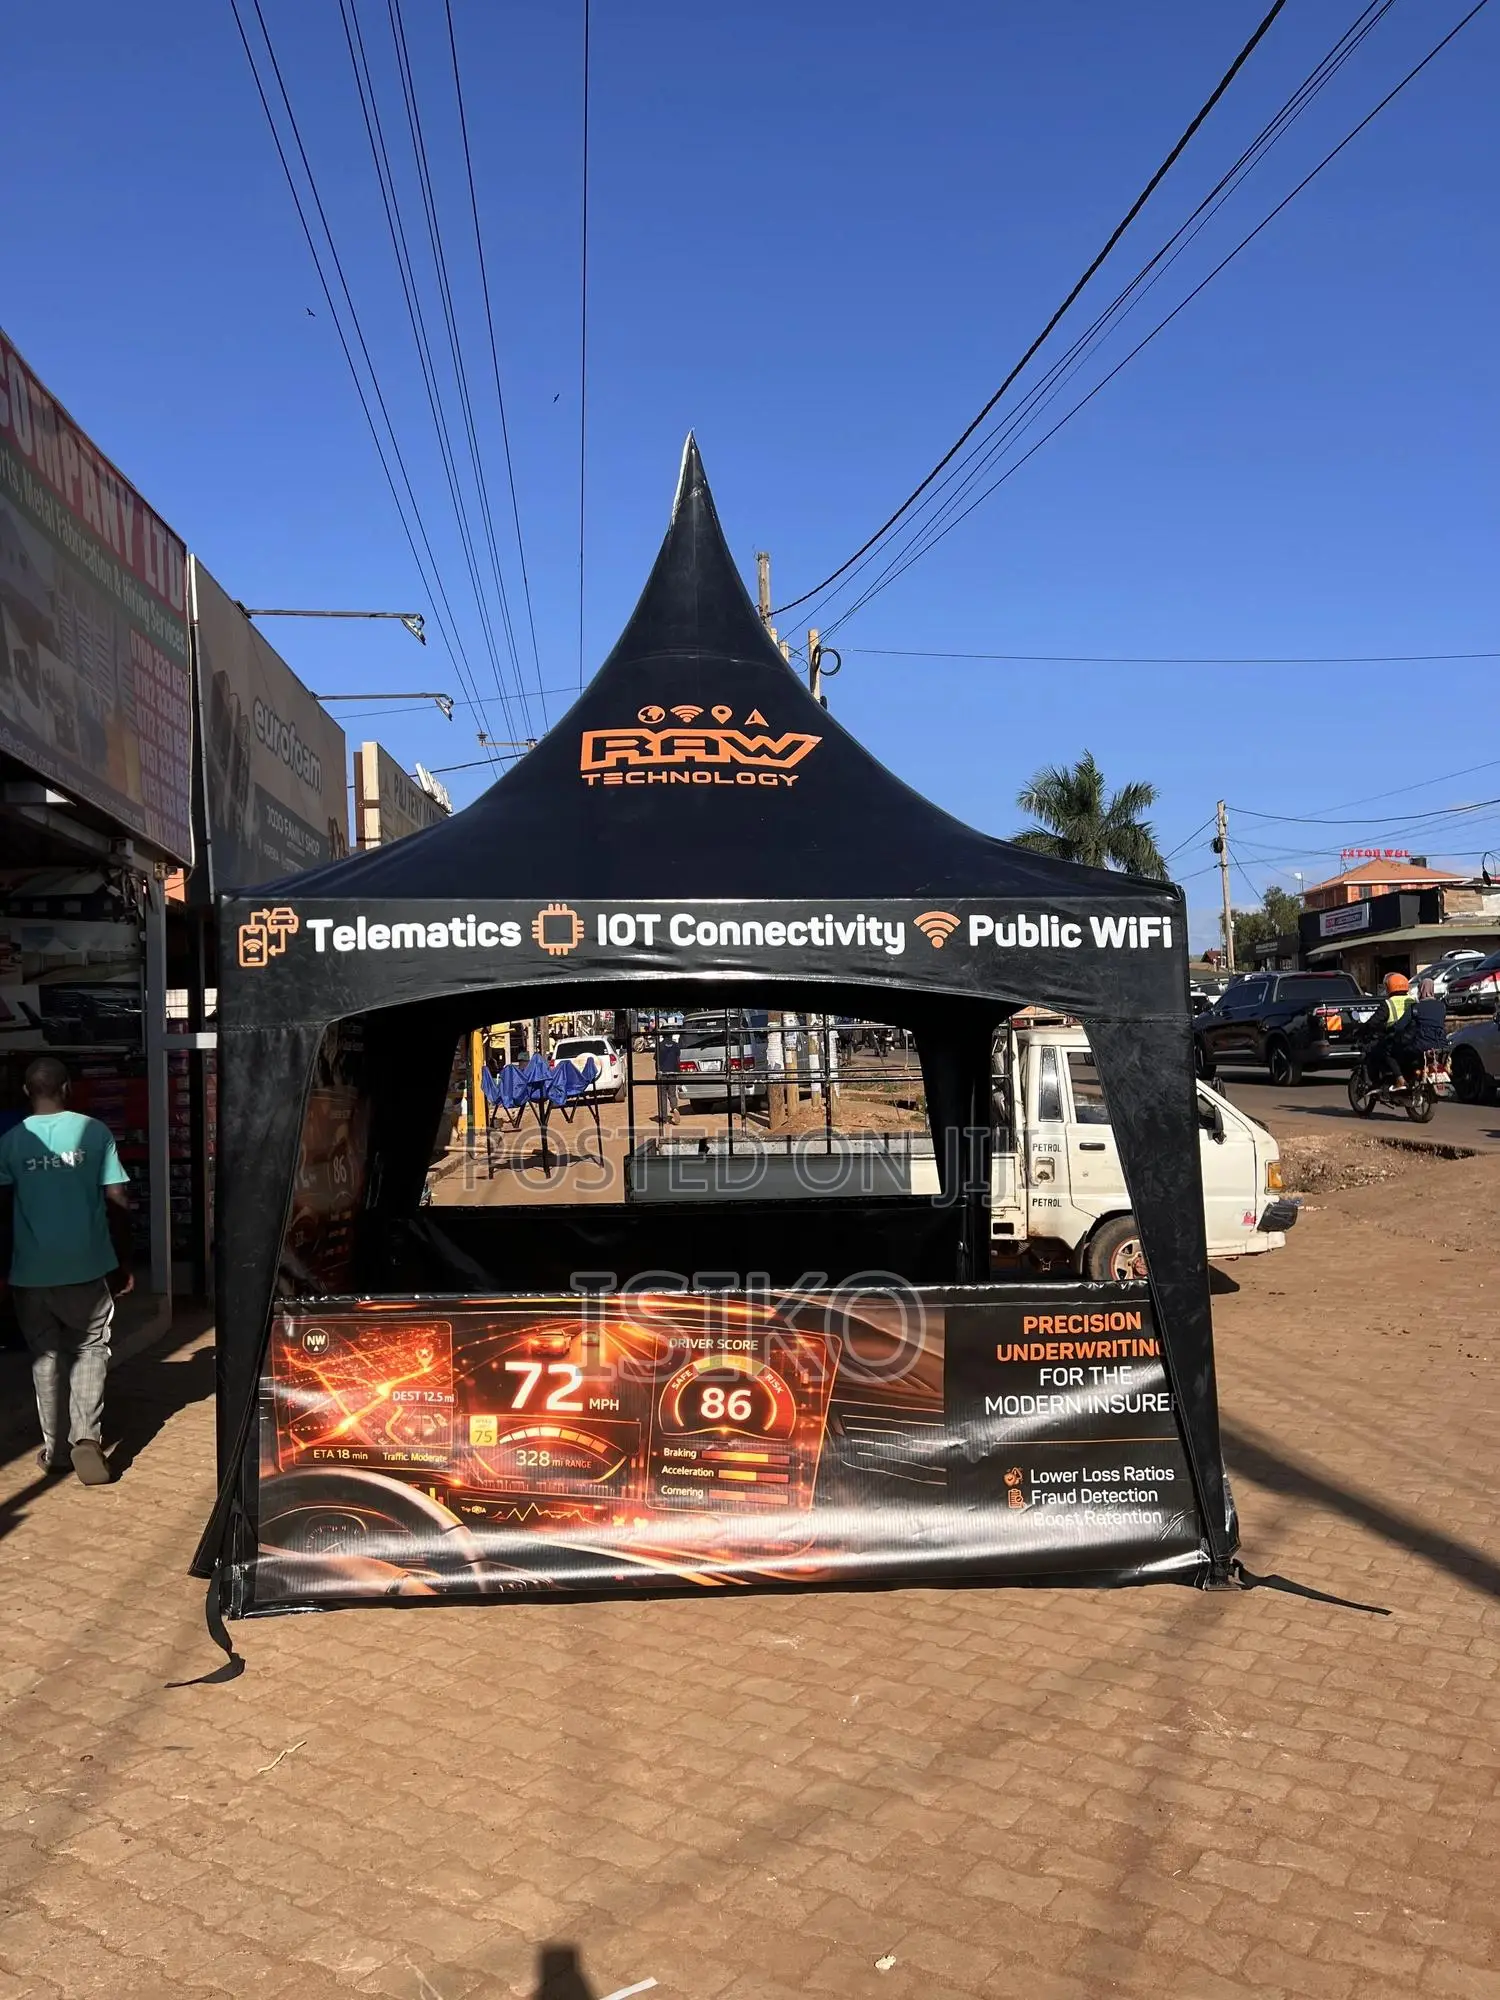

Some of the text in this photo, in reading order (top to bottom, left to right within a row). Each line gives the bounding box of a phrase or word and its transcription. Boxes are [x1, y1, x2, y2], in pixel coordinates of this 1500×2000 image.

[143, 506, 184, 612] LTD
[151, 600, 185, 655] Services
[253, 697, 322, 793] eurofoam
[580, 728, 823, 771] RAW
[581, 771, 799, 787] TECHNOLOGY
[305, 914, 522, 953] Telematics
[598, 913, 906, 955] IOT Connectivity
[968, 914, 1173, 949] Public WiFi
[1032, 1143, 1062, 1152] PETROL
[1032, 1198, 1062, 1207] PETROL
[1023, 1311, 1142, 1335] PRECISION
[306, 1335, 326, 1346] NW
[669, 1338, 759, 1351] DRIVER SCORE
[671, 1370, 693, 1390] SAFE
[764, 1373, 784, 1394] RISK
[1039, 1366, 1133, 1386] FOR THE
[505, 1361, 584, 1412] 72
[392, 1391, 455, 1403] DEST 12.5 mi
[589, 1398, 620, 1411] MPH
[700, 1387, 752, 1421] 86
[985, 1395, 1081, 1415] MODERN
[474, 1430, 493, 1443] 75
[313, 1449, 368, 1460] ETA 18 min
[411, 1452, 448, 1463] Moderate
[516, 1450, 592, 1469] 328 mi RANGE
[663, 1447, 697, 1459] Braking
[661, 1465, 714, 1477] Acceleration
[1030, 1466, 1175, 1484] Lower Loss Ratios
[661, 1485, 704, 1498] Cornering
[1031, 1487, 1158, 1505] Fraud Detection
[1033, 1509, 1162, 1527] Boost Retention
